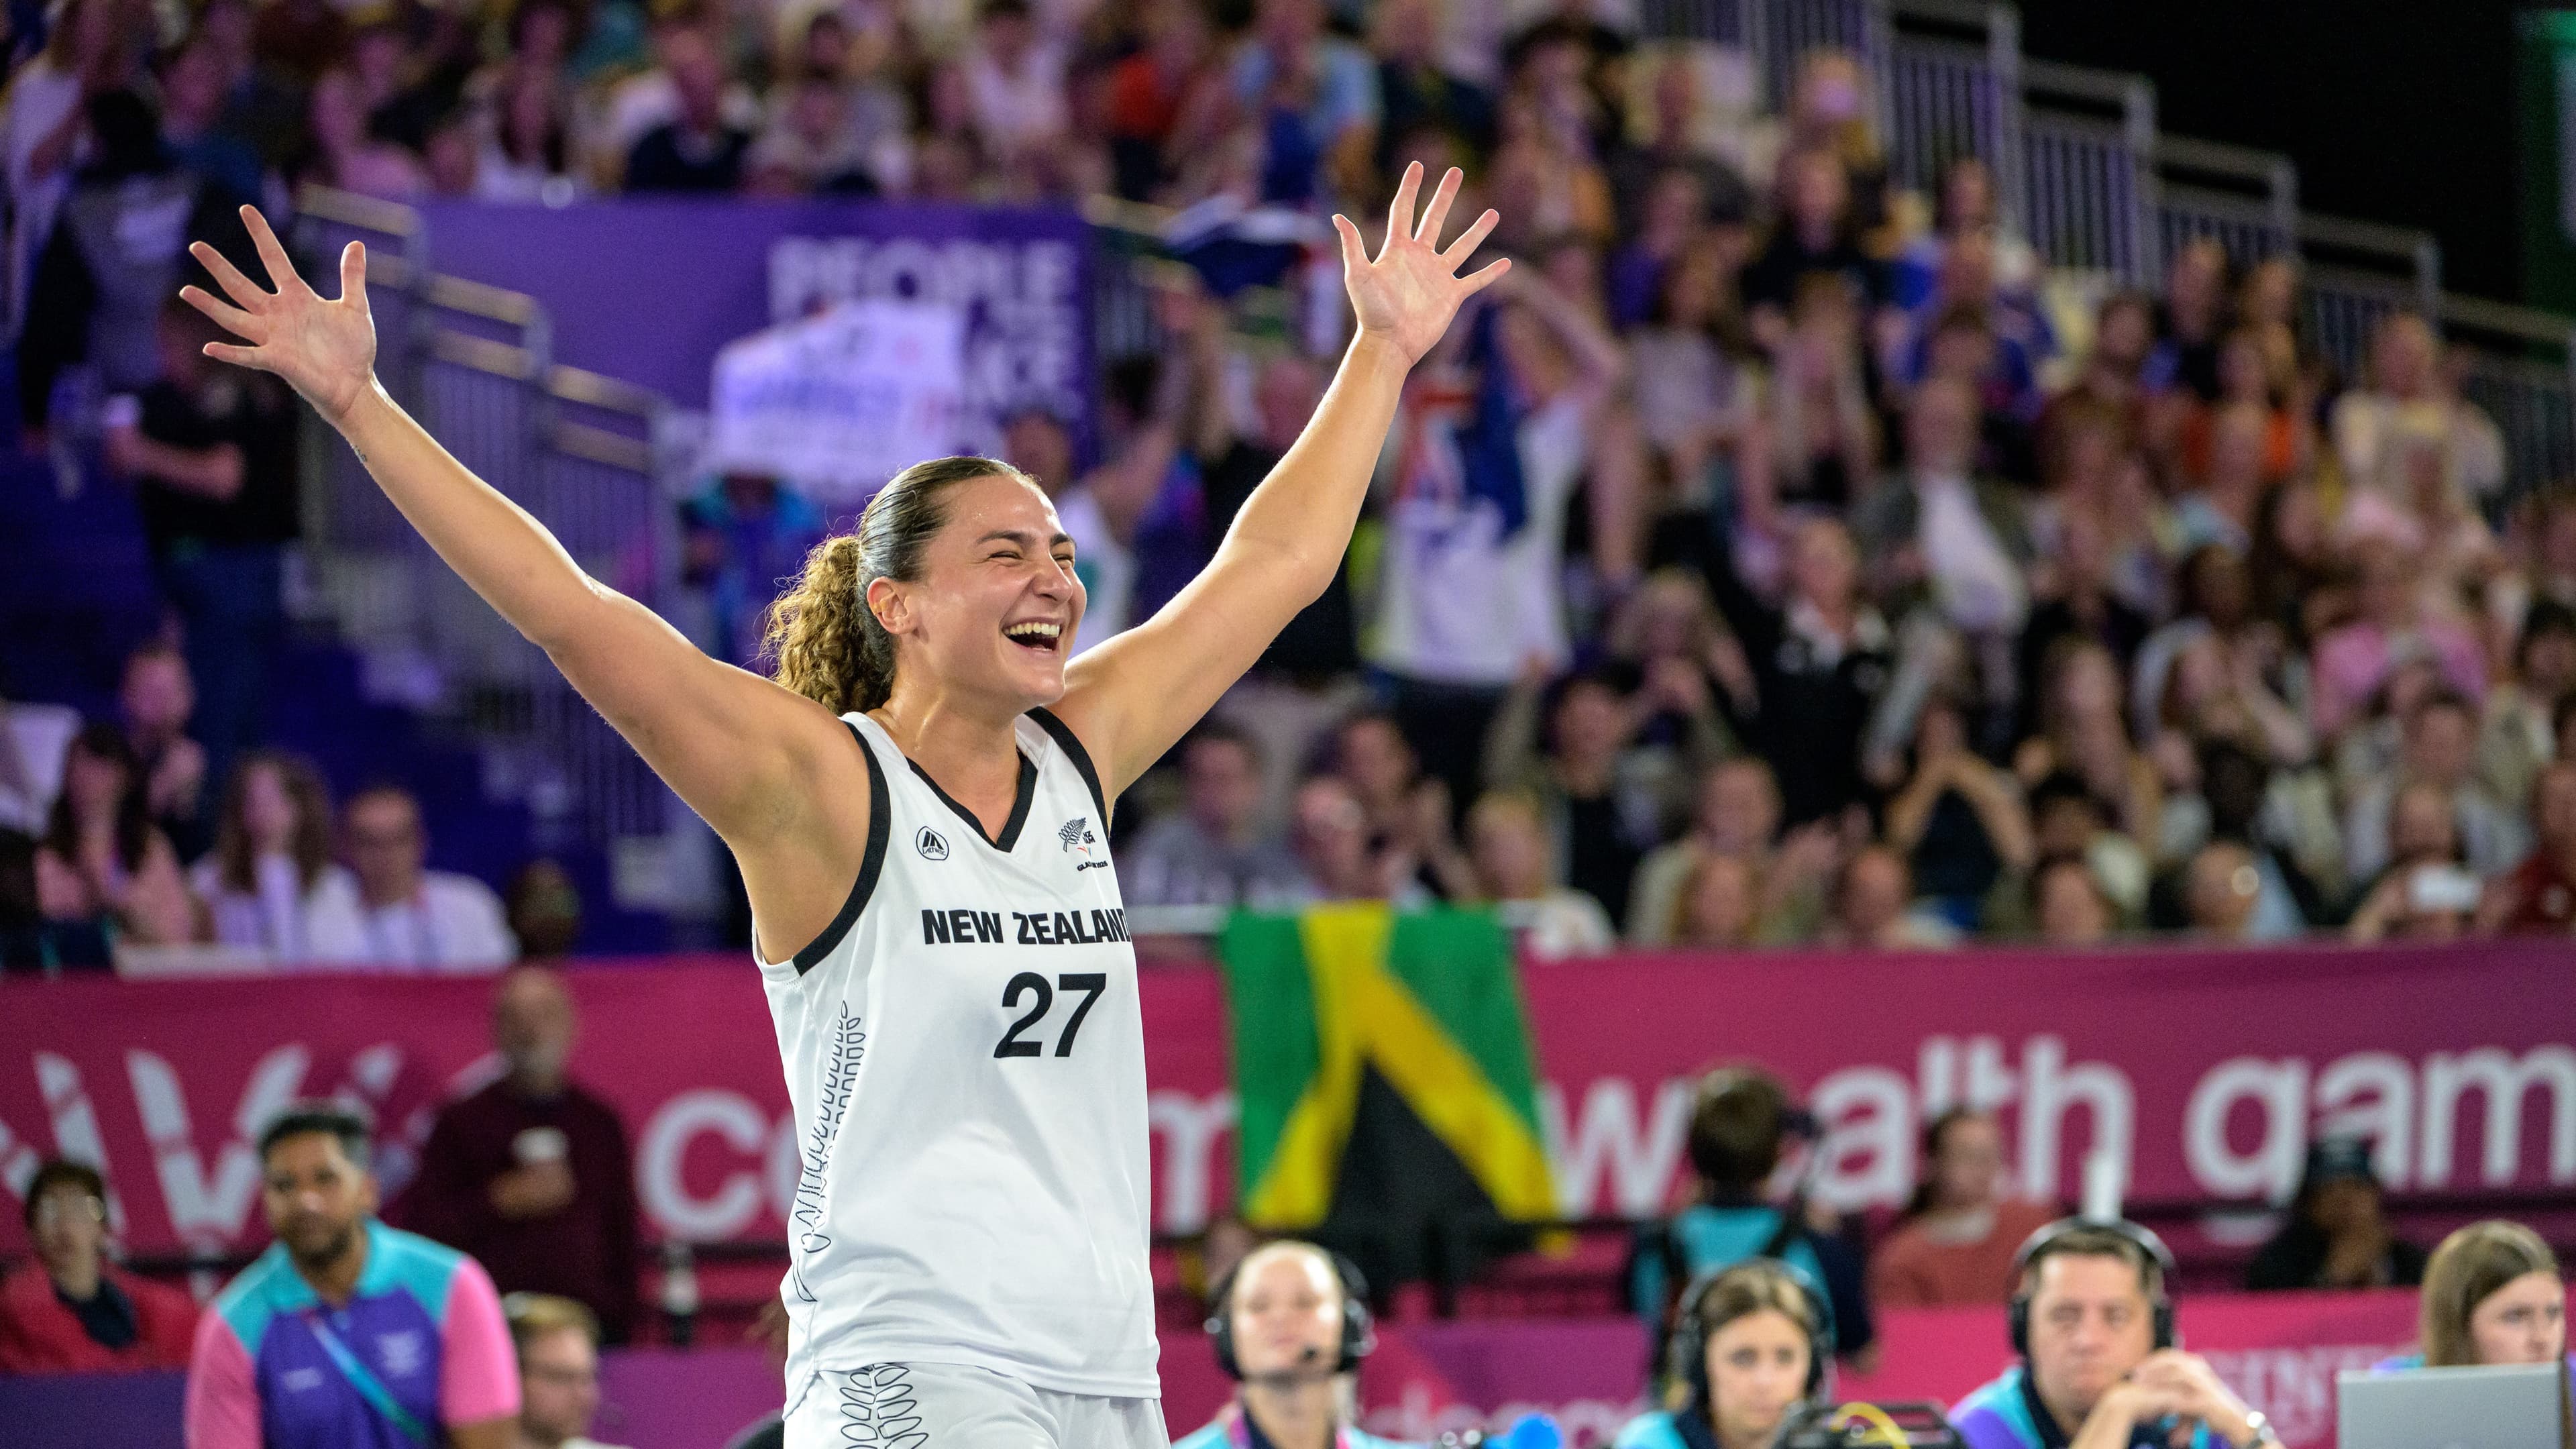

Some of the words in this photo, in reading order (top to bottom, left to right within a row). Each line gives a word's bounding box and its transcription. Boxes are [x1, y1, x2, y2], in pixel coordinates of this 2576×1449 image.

[922, 910, 1004, 945] NEW
[1012, 908, 1131, 945] ZEALAND
[994, 972, 1106, 1058] 27
